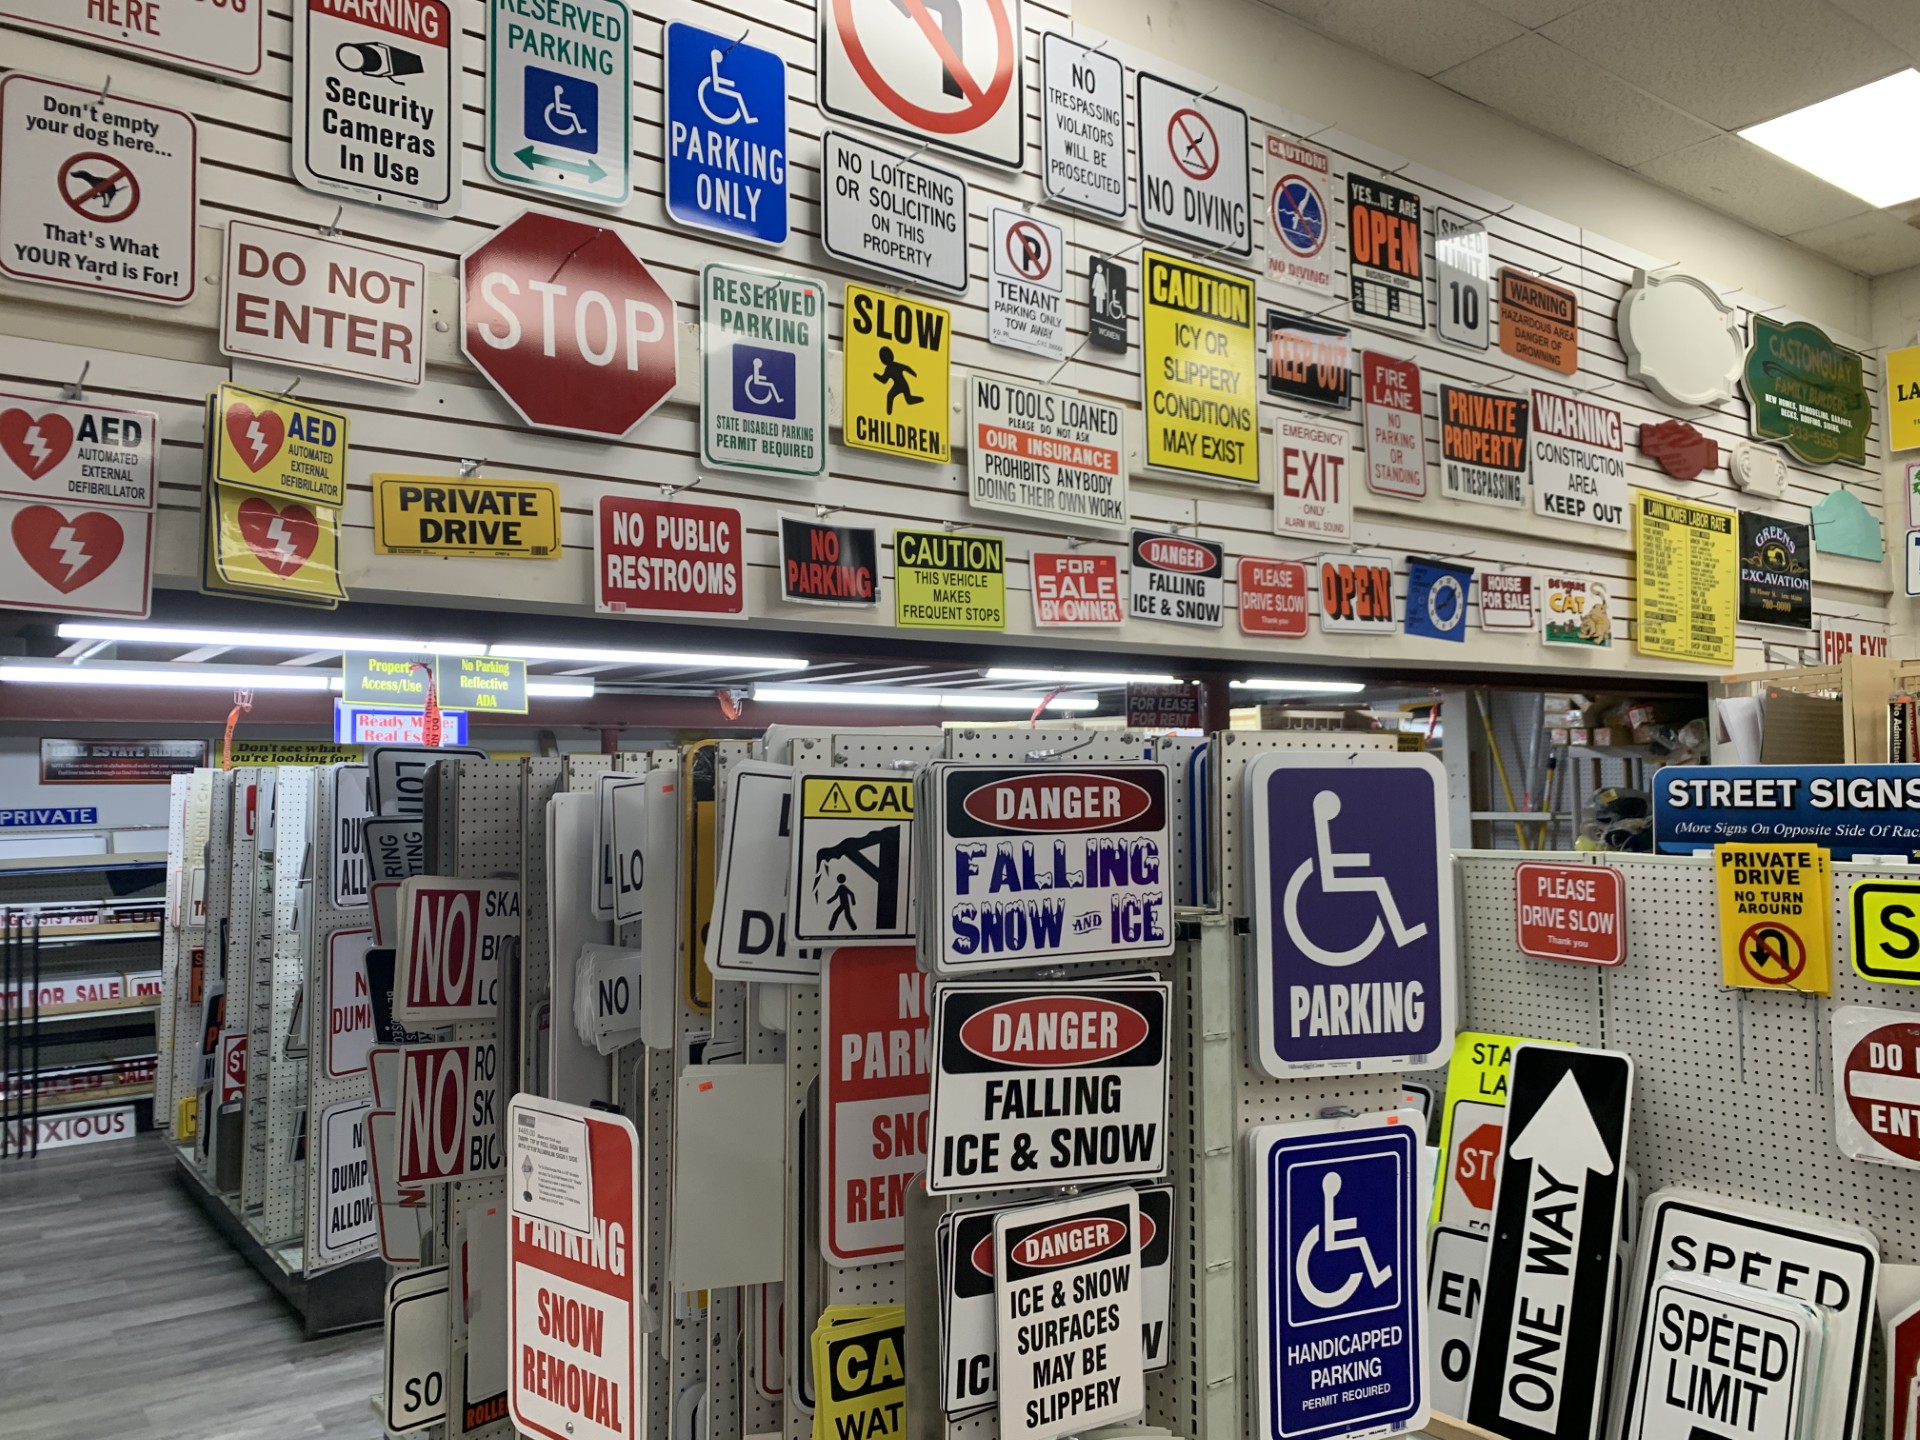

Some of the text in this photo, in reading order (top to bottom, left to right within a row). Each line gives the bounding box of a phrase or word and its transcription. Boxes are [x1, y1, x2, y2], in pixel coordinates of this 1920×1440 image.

[508, 24, 613, 75] PARKING
[43, 95, 160, 138] Don't empty
[26, 113, 173, 157] your dog here...
[671, 120, 784, 185] PARKING
[1269, 139, 1327, 172] CAUTION!
[696, 173, 762, 223] ONLY
[1147, 174, 1244, 239] NO DIVING
[1399, 198, 1417, 218] ARE
[43, 223, 160, 259] That's What
[1353, 204, 1419, 277] OPEN
[14, 244, 179, 287] YOUR Yard is For!
[238, 243, 415, 309] DO NOT
[997, 280, 1060, 313] TENANT
[1153, 264, 1247, 323] CAUTION
[1450, 281, 1478, 330] 10
[1510, 280, 1568, 317] WARNING
[235, 294, 414, 364] ENTER
[477, 271, 665, 372] STOP
[852, 293, 944, 352] SLOW
[994, 300, 1062, 329] PARKING ONLY
[1004, 317, 1053, 340] TOW AWAY
[1501, 307, 1575, 343] HAZARDOUS AREA
[1098, 327, 1120, 341] WOMEN
[1175, 322, 1228, 358] ICY OR
[1515, 327, 1562, 351] DANGER OF
[1271, 328, 1347, 393] KEEP OUT
[1516, 342, 1561, 366] DROWNING
[1164, 356, 1240, 395] SLIPPERY
[1375, 366, 1408, 389] FIRE
[977, 381, 1118, 437] NO TOOLS LOANED
[1153, 390, 1250, 431] CONDITIONS
[1373, 385, 1413, 410] LANE
[288, 412, 337, 447] AED
[856, 415, 941, 455] CHILDREN
[1008, 417, 1090, 444] PLEASE DO NOT ASK
[1283, 424, 1343, 446] EMERGENCY
[1375, 428, 1415, 449] PARKING
[1388, 413, 1400, 429] NO
[287, 443, 334, 465] AUTOMATED
[985, 429, 1112, 470] OUR INSURANCE
[1163, 428, 1245, 465] MAY EXIST
[1390, 448, 1403, 464] OR
[280, 474, 339, 497] DEFIBRILLATOR
[290, 460, 330, 480] EXTERNAL
[985, 454, 1113, 496] PROHIBITS ANYBODY
[1283, 447, 1344, 504] EXIT
[1374, 464, 1420, 486] STANDING
[400, 487, 538, 517] PRIVATE
[977, 475, 1123, 520] DOING THEIR OWN WORK
[419, 518, 523, 546] DRIVE
[612, 511, 731, 554] NO PUBLIC
[1285, 517, 1344, 533] ALARM WILL SOUND
[1648, 501, 1725, 532] LAWN MOWER LABOR RATE
[811, 528, 839, 563] NO
[1755, 526, 1795, 554] GREENS
[607, 554, 737, 596] RESTROOMS
[787, 559, 872, 599] PARKING
[1322, 562, 1392, 622] OPEN
[1488, 576, 1521, 591] HOUSE
[1742, 569, 1809, 590] EXCAVATION
[1483, 591, 1530, 610] FOR SALE
[1550, 593, 1585, 614] CAT
[362, 678, 422, 692] Access/Use
[460, 676, 509, 691] Reflective
[461, 659, 510, 676] No Parking
[476, 694, 497, 708] ADA
[1130, 699, 1195, 711] FOR LEASE
[1133, 684, 1190, 696] FOR SALE
[359, 715, 404, 729] Ready
[364, 730, 398, 742] Real
[1131, 712, 1190, 725] FOR RENT
[238, 742, 343, 754] Don't see what
[271, 753, 357, 765] looking for?
[995, 786, 1121, 821] DANGER
[1668, 778, 1920, 809] STREET SIGNS
[0, 809, 94, 825] PRIVATE
[1675, 822, 1889, 840] (More Signs On Opposite Side Of
[955, 836, 1160, 895] FALLING
[1538, 877, 1595, 901] PLEASE
[951, 891, 1164, 955] SNOW AND ICE
[1523, 905, 1613, 934] DRIVE SLOW
[413, 892, 471, 1005] NO
[1547, 935, 1588, 948] Thank you
[1290, 981, 1425, 1038] PARKING
[2, 1112, 124, 1147] ANXIOUS
[401, 1050, 462, 1175] NO
[1025, 1223, 1110, 1263] DANGER
[1010, 1265, 1131, 1320] ICE & SNOW
[1508, 1164, 1579, 1412] ONE WAY
[537, 1287, 603, 1357] SNOW
[1017, 1304, 1120, 1356] SURFACES
[1659, 1302, 1789, 1382] SPEED
[1033, 1343, 1107, 1389] MAY BE
[523, 1344, 621, 1433] REMOVAL
[1025, 1376, 1122, 1429] SLIPPERY
[1666, 1357, 1768, 1433] LIMIT
